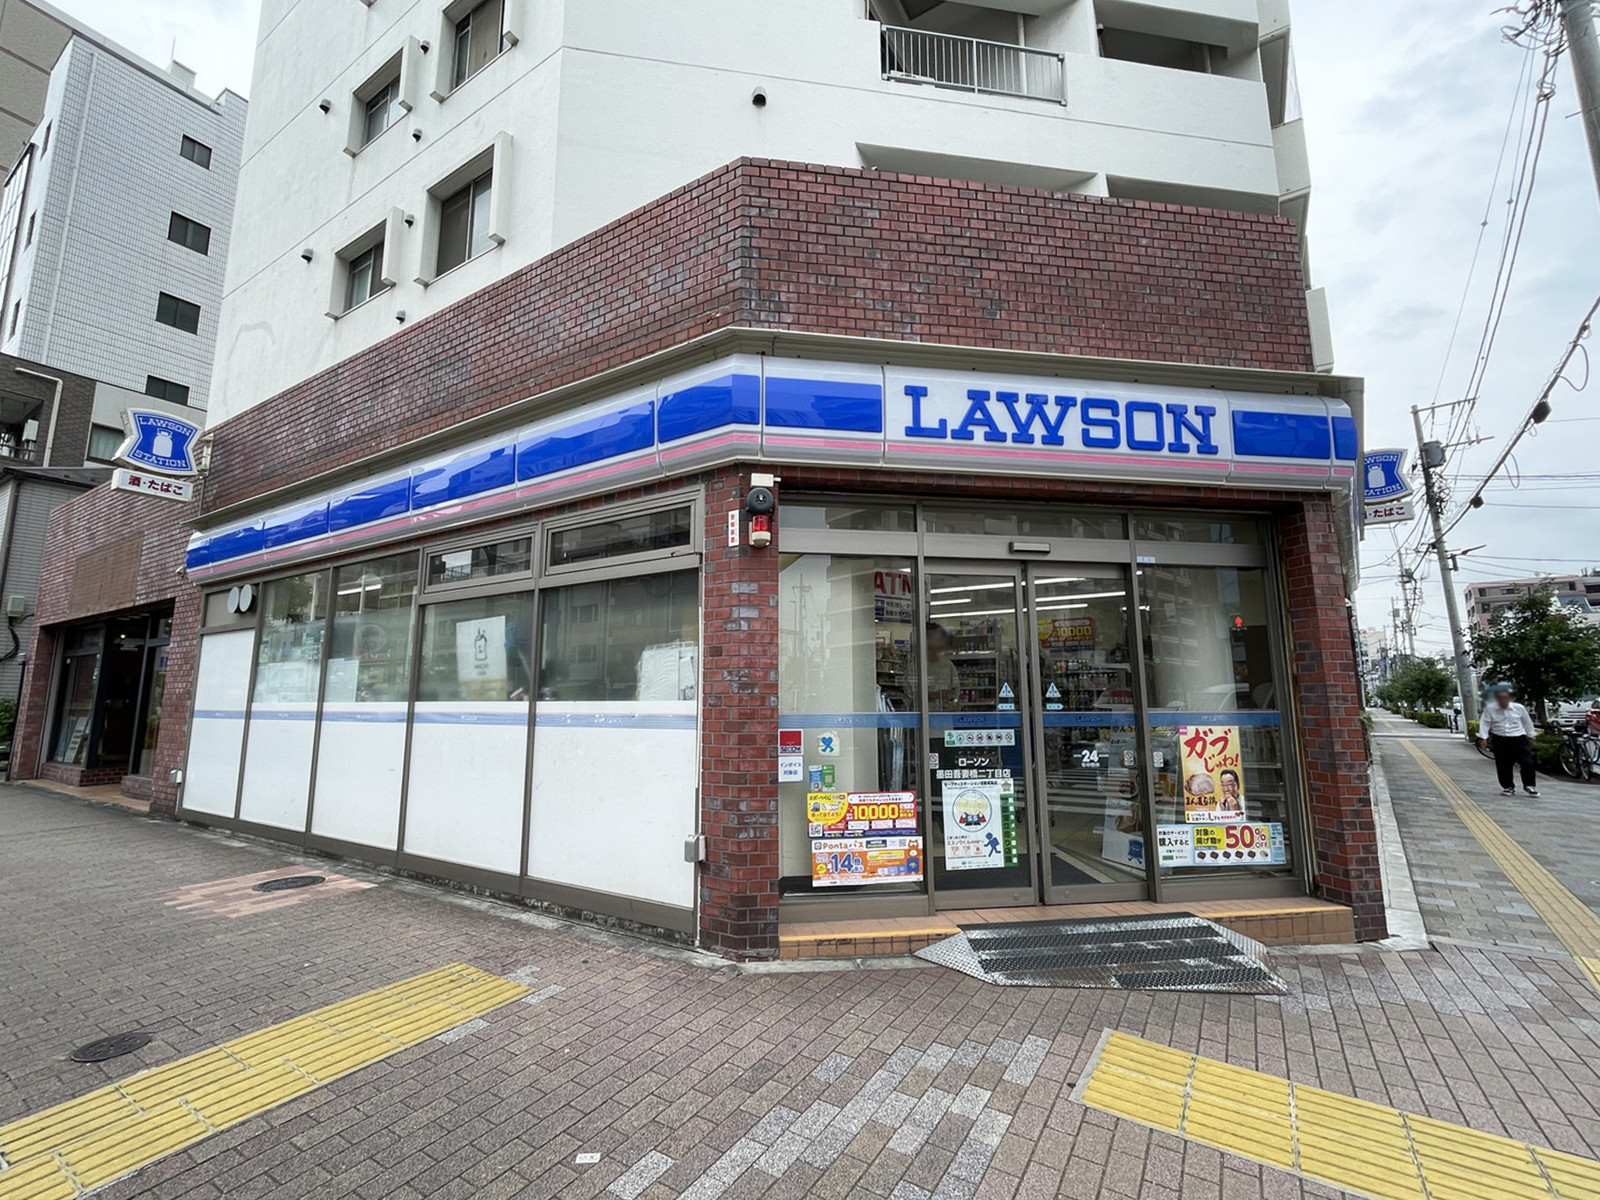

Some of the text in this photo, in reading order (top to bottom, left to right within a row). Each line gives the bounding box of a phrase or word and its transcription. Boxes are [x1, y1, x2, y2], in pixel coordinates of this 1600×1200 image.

[138, 416, 192, 437] LAWSON
[904, 385, 1219, 455] LAWSON
[133, 449, 187, 468] STATION
[1364, 454, 1398, 465] WSON
[128, 475, 183, 496] 酒・たばこ
[1364, 483, 1402, 496] TATION
[1363, 506, 1406, 520] ・たばこ
[958, 758, 990, 767] ローソン
[1081, 750, 1099, 762] 24
[823, 840, 864, 850] Pontaパス
[1158, 837, 1189, 847] 購入すると
